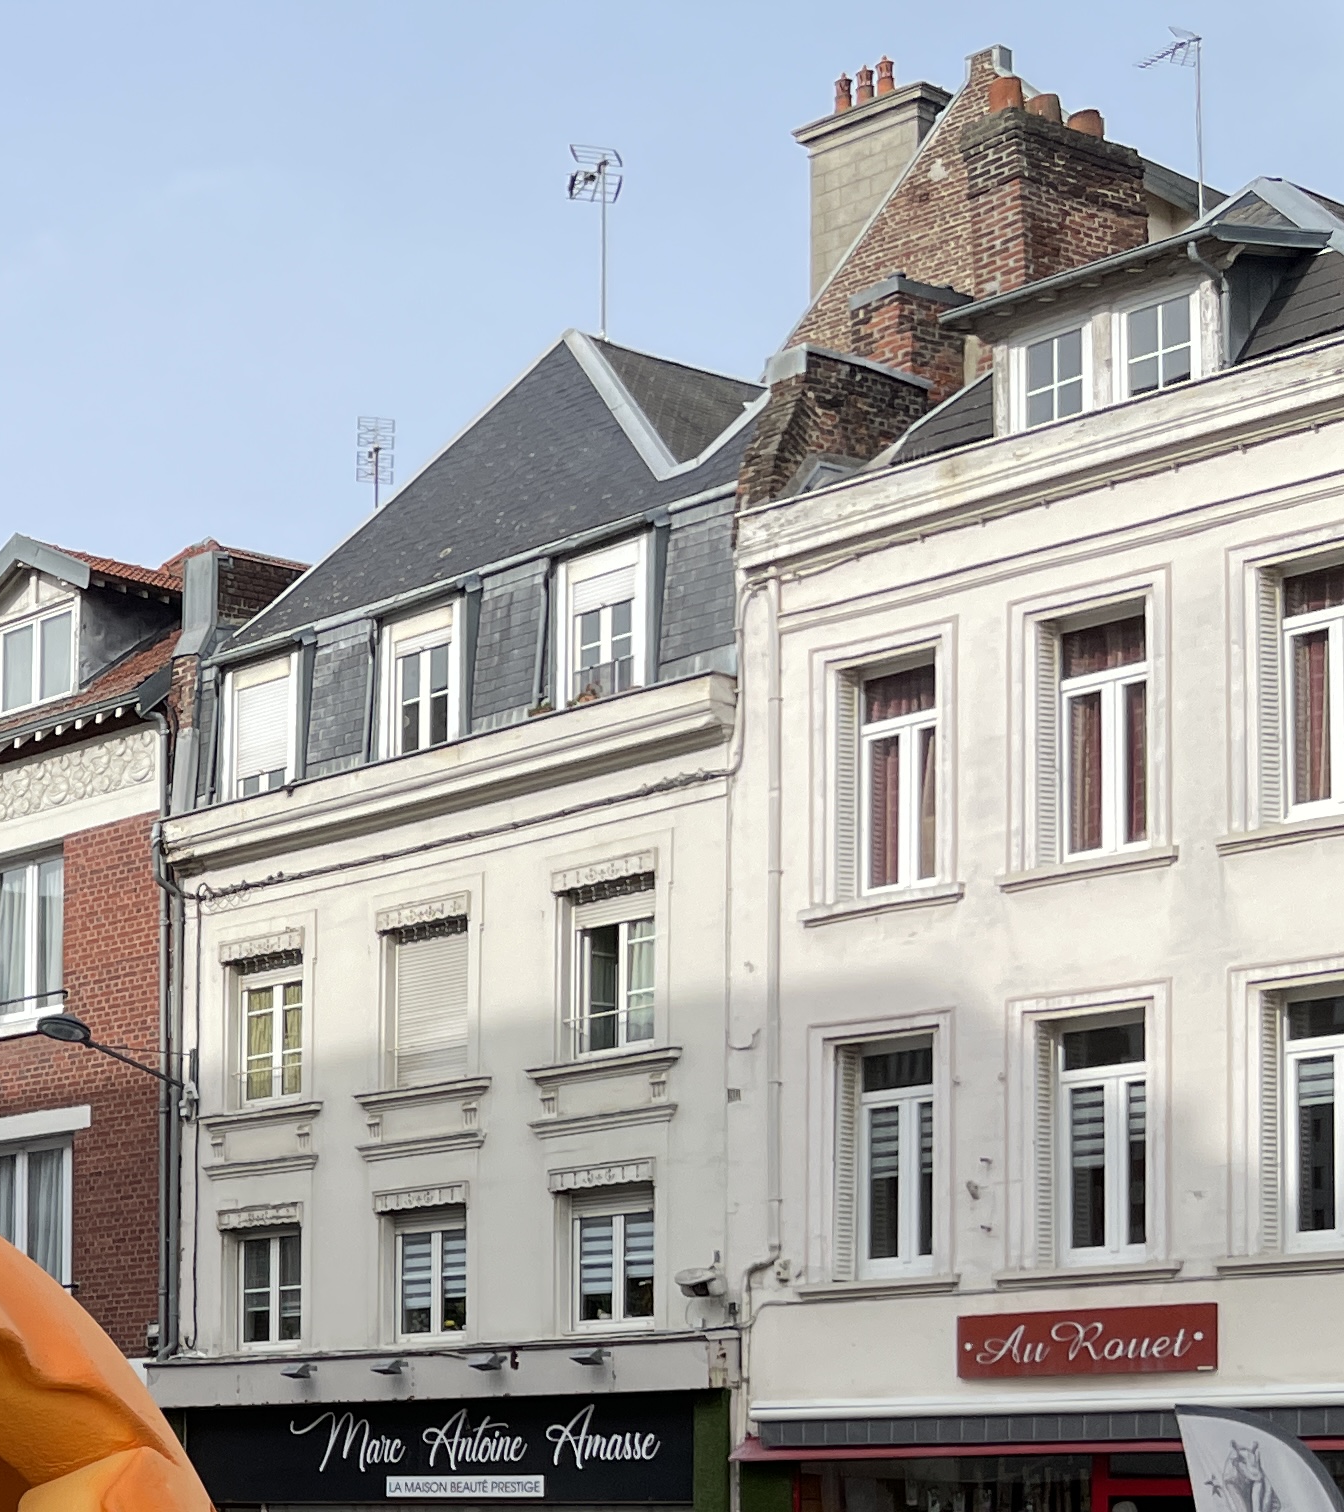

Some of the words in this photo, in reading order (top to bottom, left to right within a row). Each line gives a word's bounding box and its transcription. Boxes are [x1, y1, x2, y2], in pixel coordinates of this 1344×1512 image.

[976, 1324, 1050, 1365] Au
[1050, 1321, 1192, 1361] Rouet
[290, 1411, 406, 1472] Marc
[422, 1408, 528, 1470] Antoine
[546, 1403, 660, 1469] Amasse
[388, 1481, 403, 1493] LA
[405, 1481, 447, 1493] MAISON
[450, 1479, 488, 1493] BEAUTÉ
[491, 1480, 541, 1493] PRESTIGE
